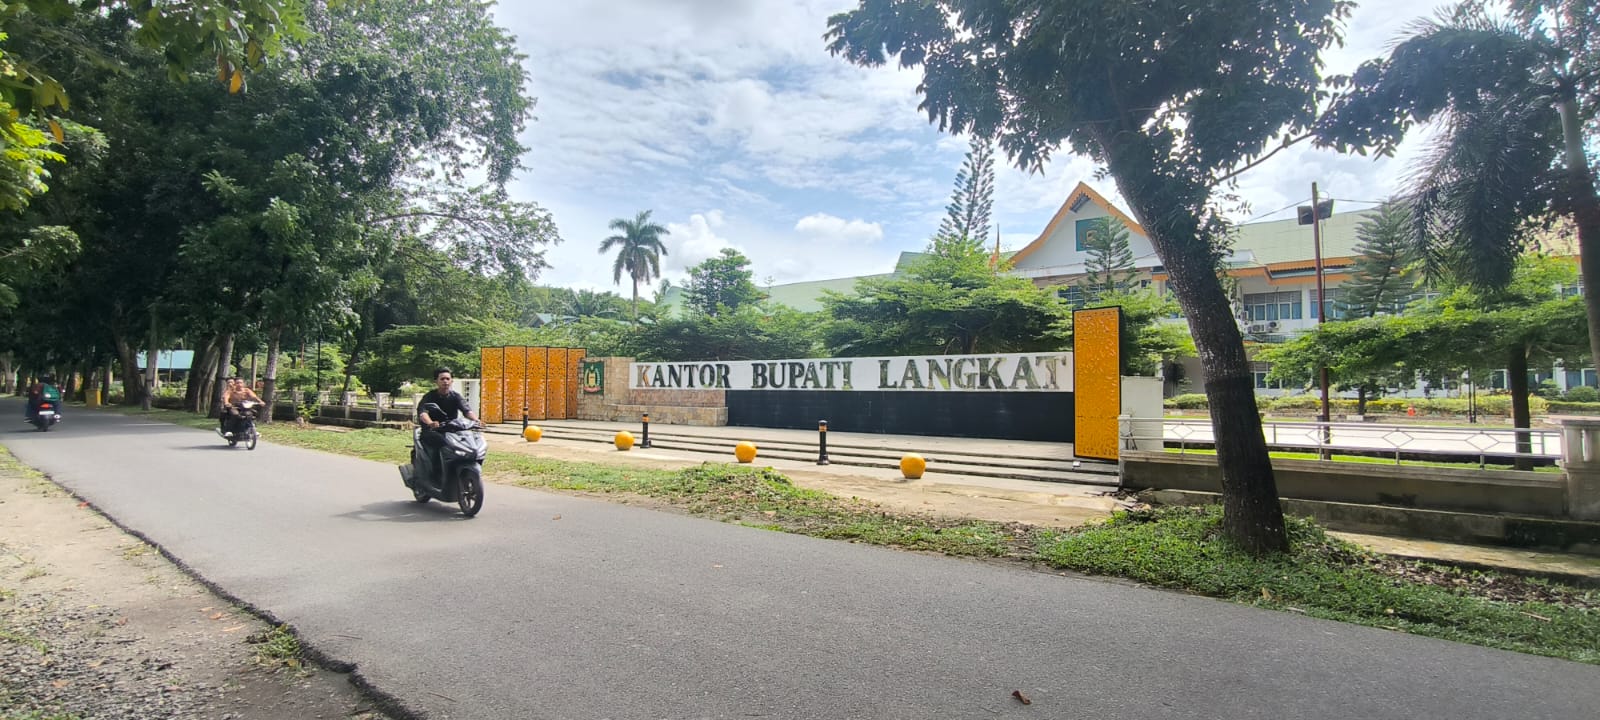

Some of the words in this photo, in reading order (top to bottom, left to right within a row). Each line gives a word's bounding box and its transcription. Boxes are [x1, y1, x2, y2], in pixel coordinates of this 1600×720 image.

[636, 362, 732, 389] KANTOR
[751, 360, 853, 389] BUPATI
[877, 355, 1067, 391] LANGKAT
